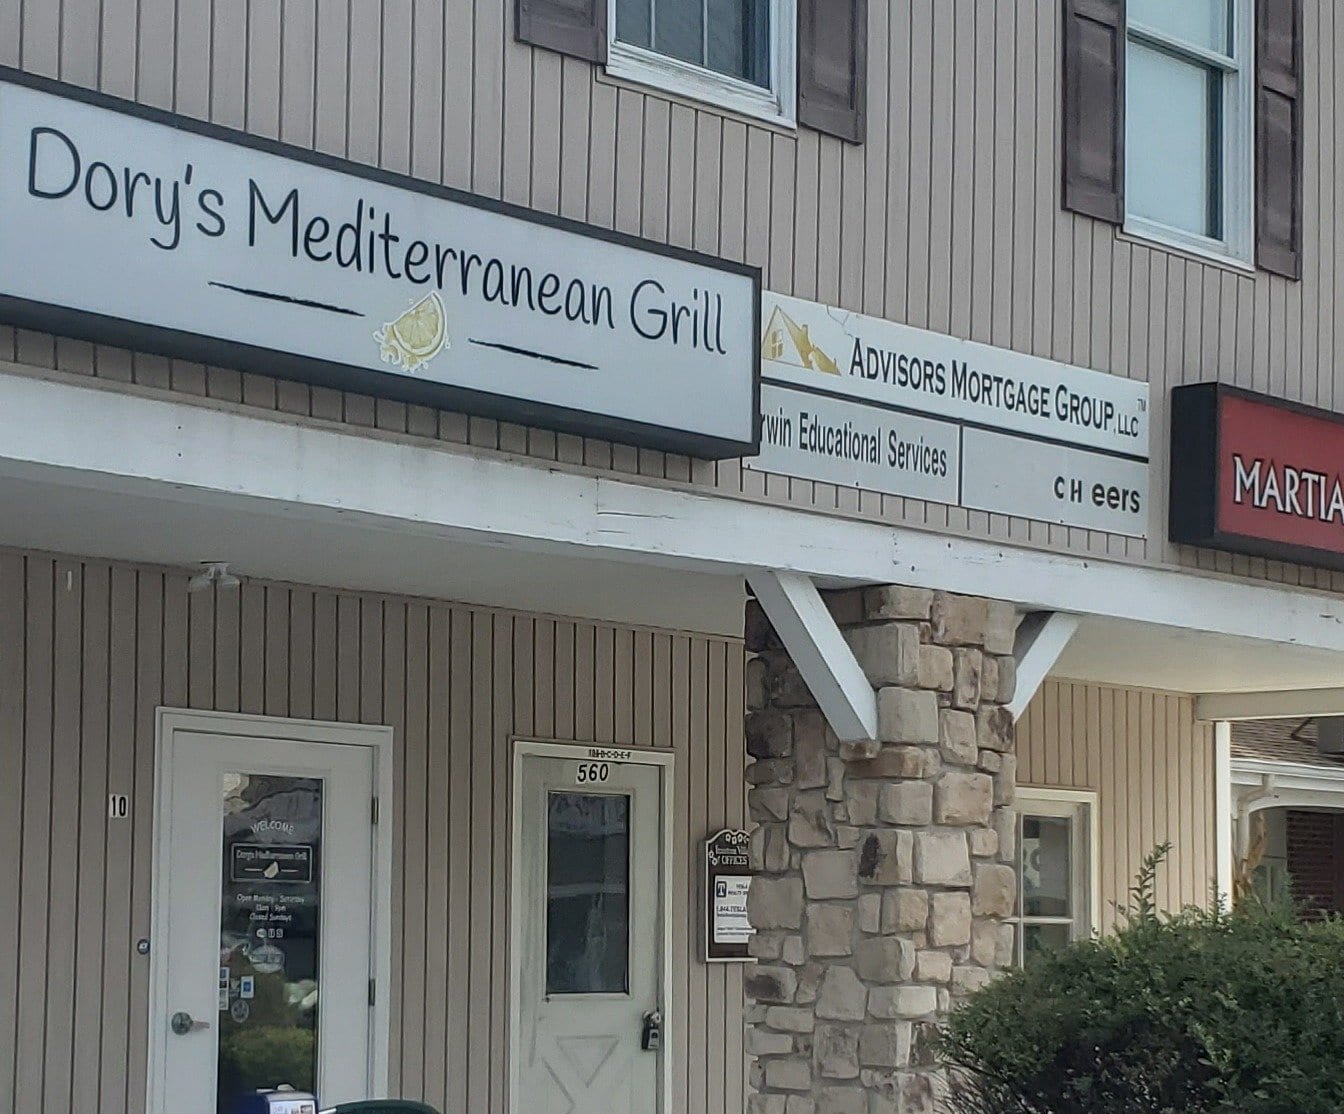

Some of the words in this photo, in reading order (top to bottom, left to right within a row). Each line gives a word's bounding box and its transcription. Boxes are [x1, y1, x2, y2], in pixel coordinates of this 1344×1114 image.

[28, 126, 225, 250] Dory's
[249, 178, 615, 329] Mediterranean
[630, 279, 726, 355] Grill
[849, 338, 945, 395] ADVISORS
[951, 360, 1050, 418] MORTGAGE
[799, 412, 881, 465] Educational
[888, 429, 947, 477] Services
[577, 763, 609, 782] 560
[112, 794, 127, 817] 10
[250, 820, 296, 836] WELCOME
